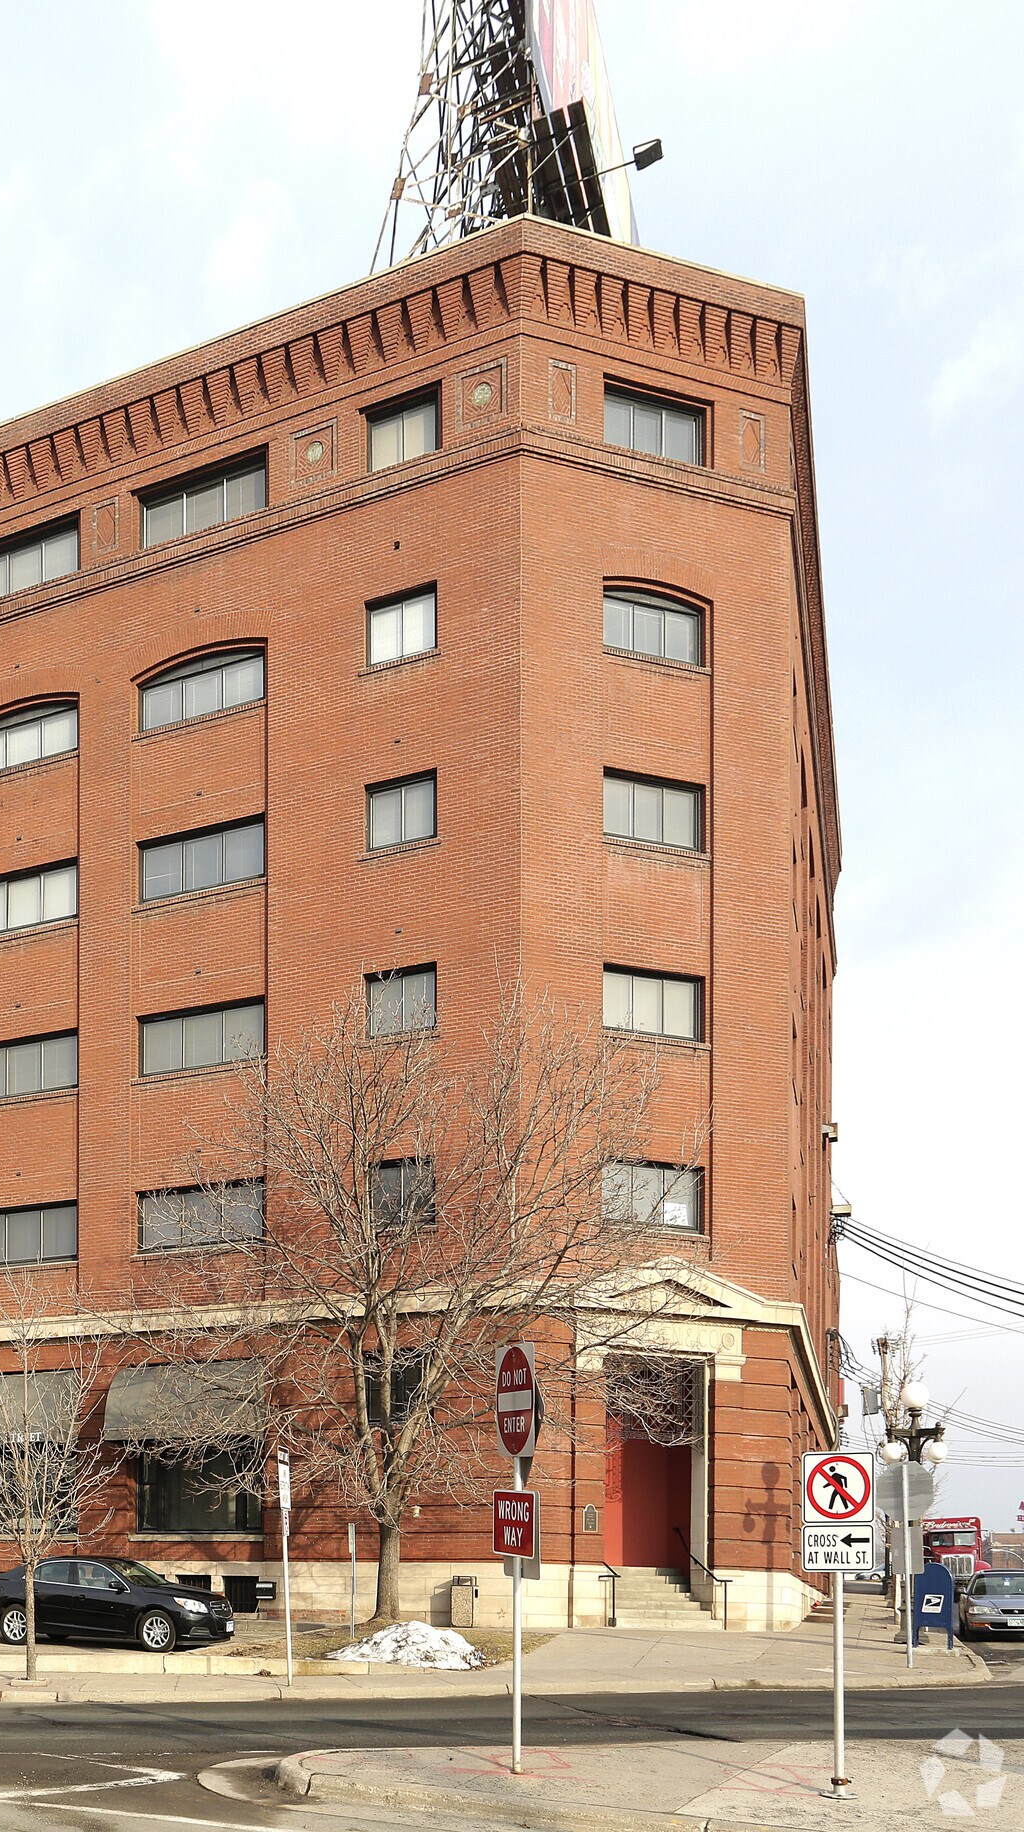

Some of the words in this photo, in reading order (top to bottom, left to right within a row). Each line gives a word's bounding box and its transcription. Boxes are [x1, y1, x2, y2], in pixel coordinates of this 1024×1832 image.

[502, 1370, 511, 1387] DO
[513, 1368, 527, 1385] NOT
[503, 1416, 525, 1434] ENTER
[497, 1500, 530, 1523] WRONG
[503, 1526, 524, 1547] WAY
[807, 1534, 837, 1548] CROSS
[807, 1551, 819, 1564] AT
[823, 1551, 851, 1564] WALL
[855, 1551, 869, 1564] ST.
